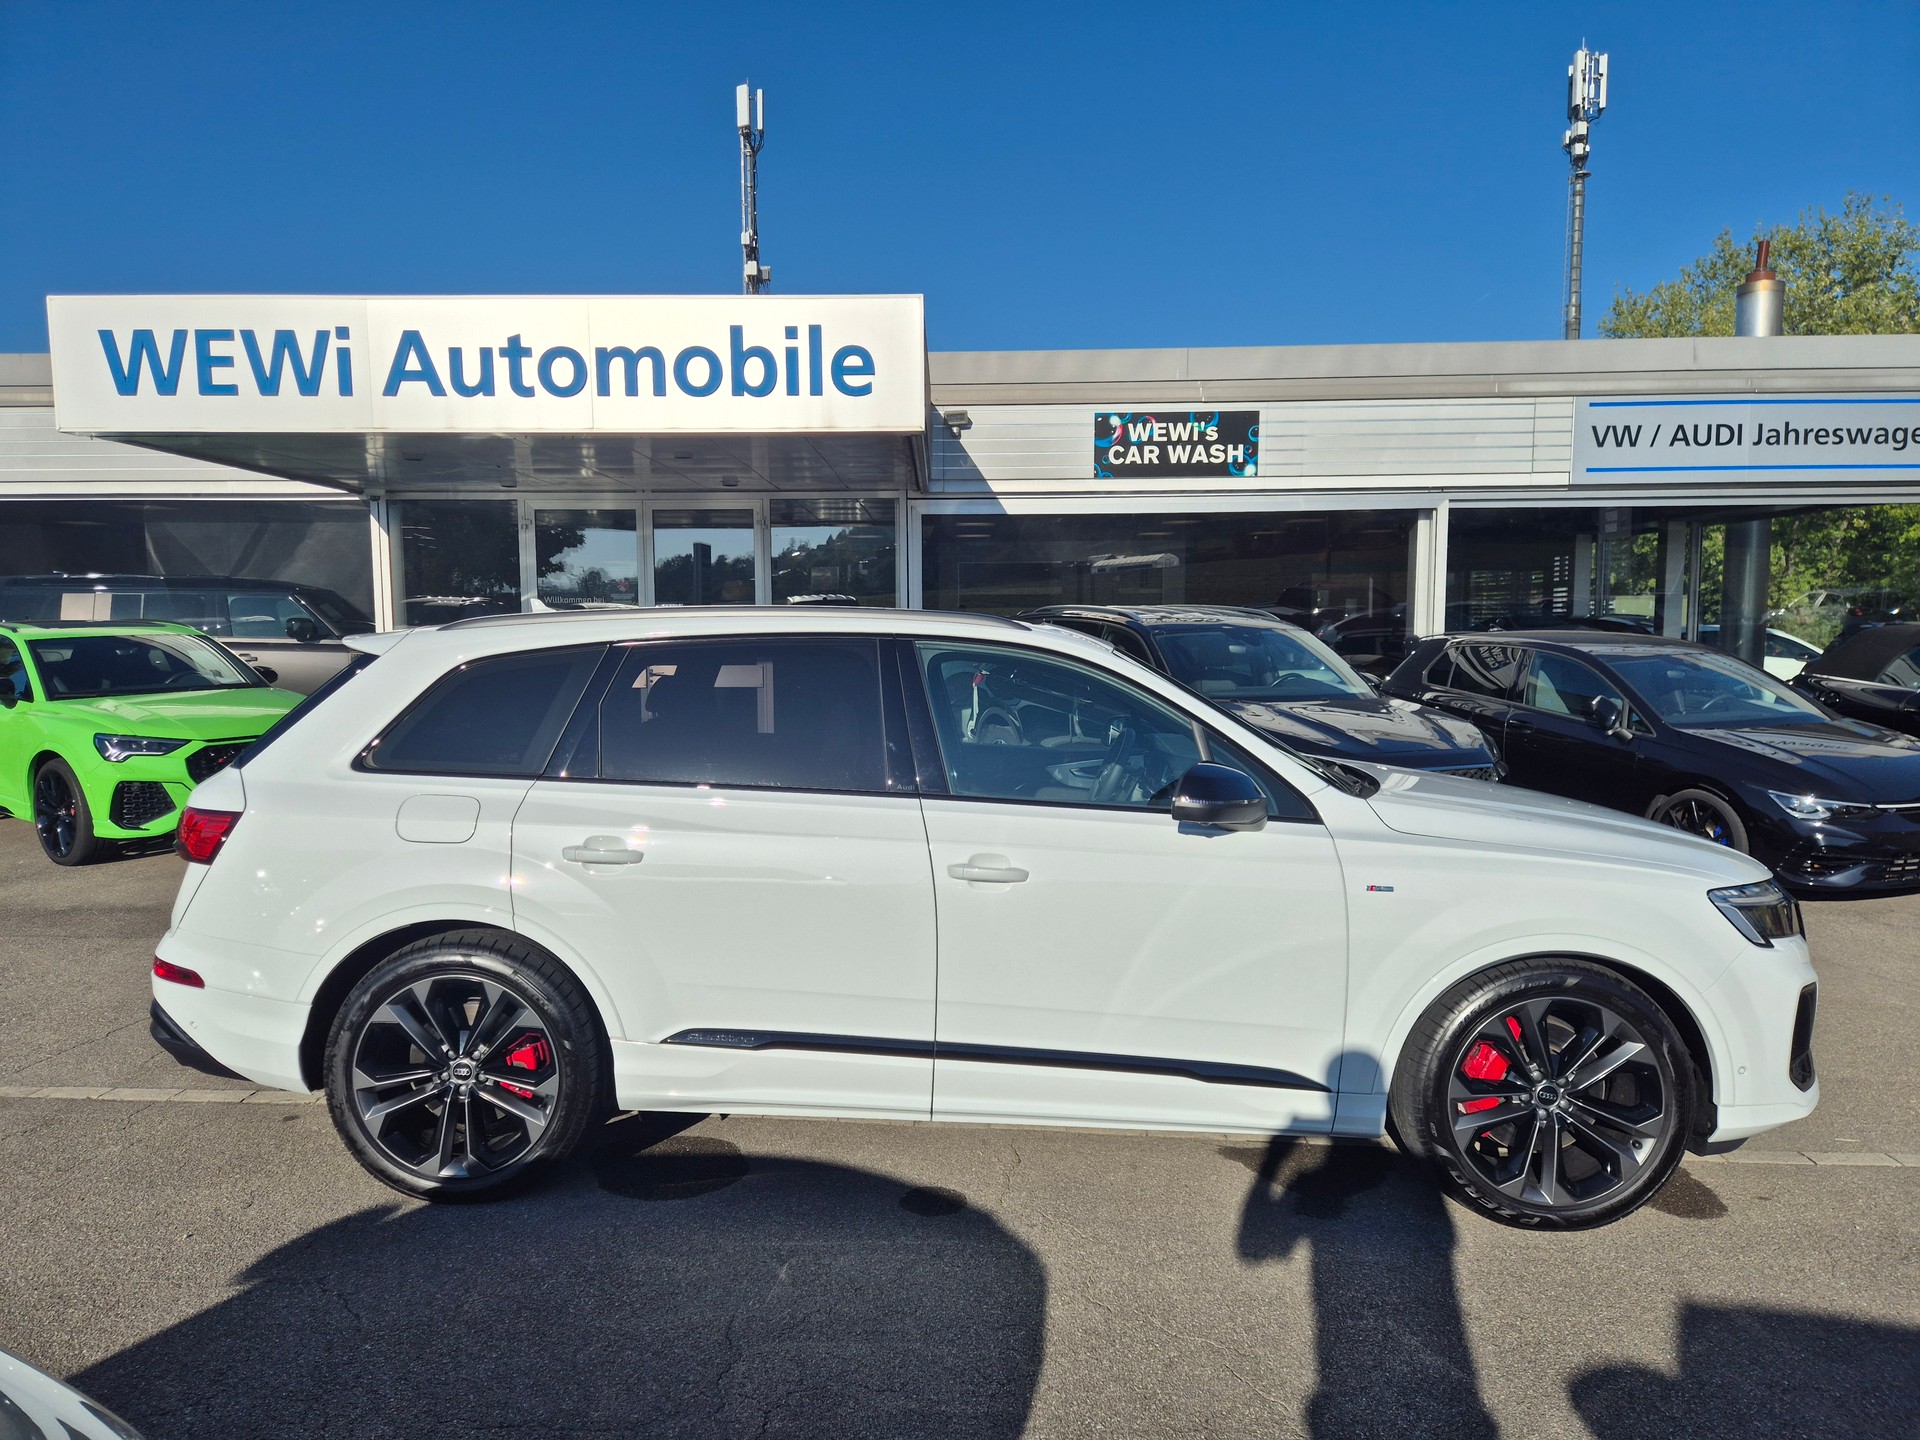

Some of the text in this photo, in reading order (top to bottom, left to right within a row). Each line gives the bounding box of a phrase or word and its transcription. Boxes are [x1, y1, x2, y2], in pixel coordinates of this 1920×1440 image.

[98, 324, 877, 399] WEWi Automobile
[1127, 421, 1219, 442] WEWi's
[1591, 424, 1643, 448] VW
[1649, 424, 1662, 448] /
[1669, 423, 1743, 447] AUDI
[1108, 444, 1244, 465] CAR WASH
